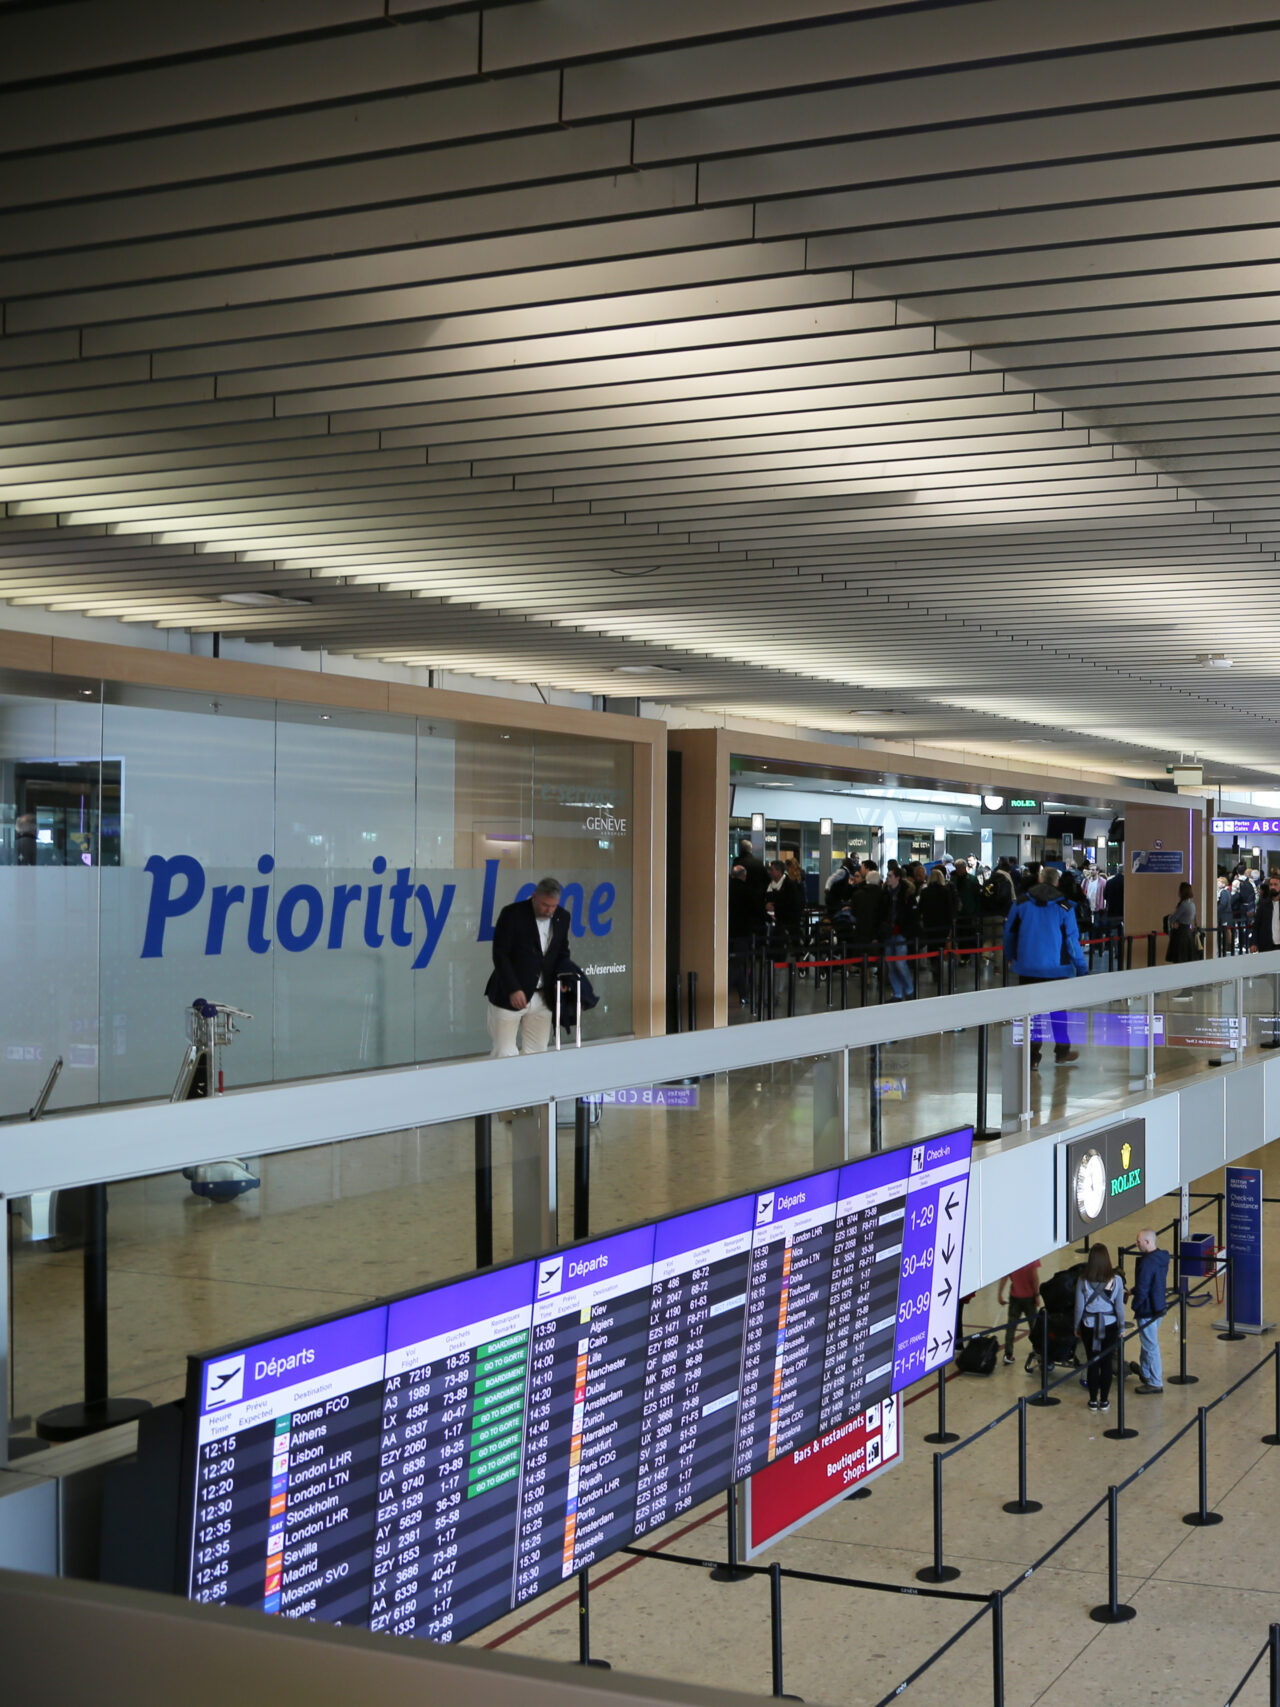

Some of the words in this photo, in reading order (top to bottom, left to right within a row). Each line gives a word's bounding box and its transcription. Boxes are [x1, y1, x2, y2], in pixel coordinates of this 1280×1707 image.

[586, 816, 626, 831] GENÈVE
[1252, 821, 1260, 831] A
[1262, 821, 1269, 831] B
[1272, 821, 1279, 831] C
[140, 854, 456, 969] Priority
[927, 1144, 951, 1161] Check-in
[1111, 1168, 1141, 1196] ROLEX
[778, 1191, 806, 1210] Départs
[1231, 1194, 1254, 1202] Check-in
[1231, 1201, 1258, 1210] Assistance
[910, 1204, 934, 1230] 1-29
[568, 1254, 608, 1278] Départs
[902, 1247, 934, 1278] 30-49
[591, 1304, 607, 1317] Kiev
[898, 1291, 930, 1323] 50-99
[590, 1317, 613, 1333] Algiers
[589, 1335, 607, 1348] Cairo
[255, 1347, 315, 1381] Départs
[586, 1357, 626, 1380] Manchester
[587, 1352, 601, 1365] Lille
[894, 1347, 926, 1378] F1-F14
[204, 1436, 236, 1458] 12:15
[292, 1407, 323, 1426] Rome
[325, 1395, 349, 1414] FCO
[385, 1376, 400, 1392] AR
[408, 1365, 431, 1383] 7219
[446, 1351, 469, 1369] 18-25
[294, 1384, 332, 1401] Destination
[203, 1457, 234, 1480] 12:20
[290, 1424, 326, 1447] Athens
[384, 1395, 397, 1410] A3
[408, 1383, 430, 1401] 1989
[444, 1369, 468, 1388] 73-89
[201, 1478, 233, 1500] 12:20
[289, 1445, 323, 1466] Lisbon
[383, 1413, 396, 1429] LX
[406, 1401, 428, 1419] 4584
[443, 1386, 467, 1405] 73-89
[794, 1447, 811, 1464] Bars
[813, 1441, 819, 1452] &
[822, 1415, 864, 1448] restaurants
[200, 1498, 232, 1521] 12:30
[288, 1462, 327, 1486] London
[329, 1450, 351, 1469] LHR
[381, 1432, 396, 1448] AA
[404, 1419, 427, 1438] 6337
[441, 1404, 466, 1422] 40-47
[827, 1446, 865, 1477] Boutiques
[843, 1462, 865, 1484] Shops
[199, 1518, 231, 1542] 12:35
[287, 1482, 325, 1506] London
[328, 1469, 349, 1488] LTN
[381, 1447, 401, 1466] EZY
[403, 1437, 426, 1457] 2060
[444, 1422, 462, 1439] 1-17
[198, 1539, 229, 1563] 12:35
[286, 1495, 338, 1525] Stockholm
[379, 1469, 394, 1484] CA
[402, 1455, 425, 1475] 6836
[440, 1439, 464, 1458] 18-25
[196, 1560, 228, 1584] 12:45
[284, 1520, 323, 1545] London
[326, 1507, 348, 1527] LHR
[195, 1580, 227, 1602] 12:55
[283, 1542, 317, 1565] Sevilla
[281, 1576, 323, 1604] Moscow
[325, 1562, 348, 1583] SVO
[282, 1558, 317, 1585] Madrid
